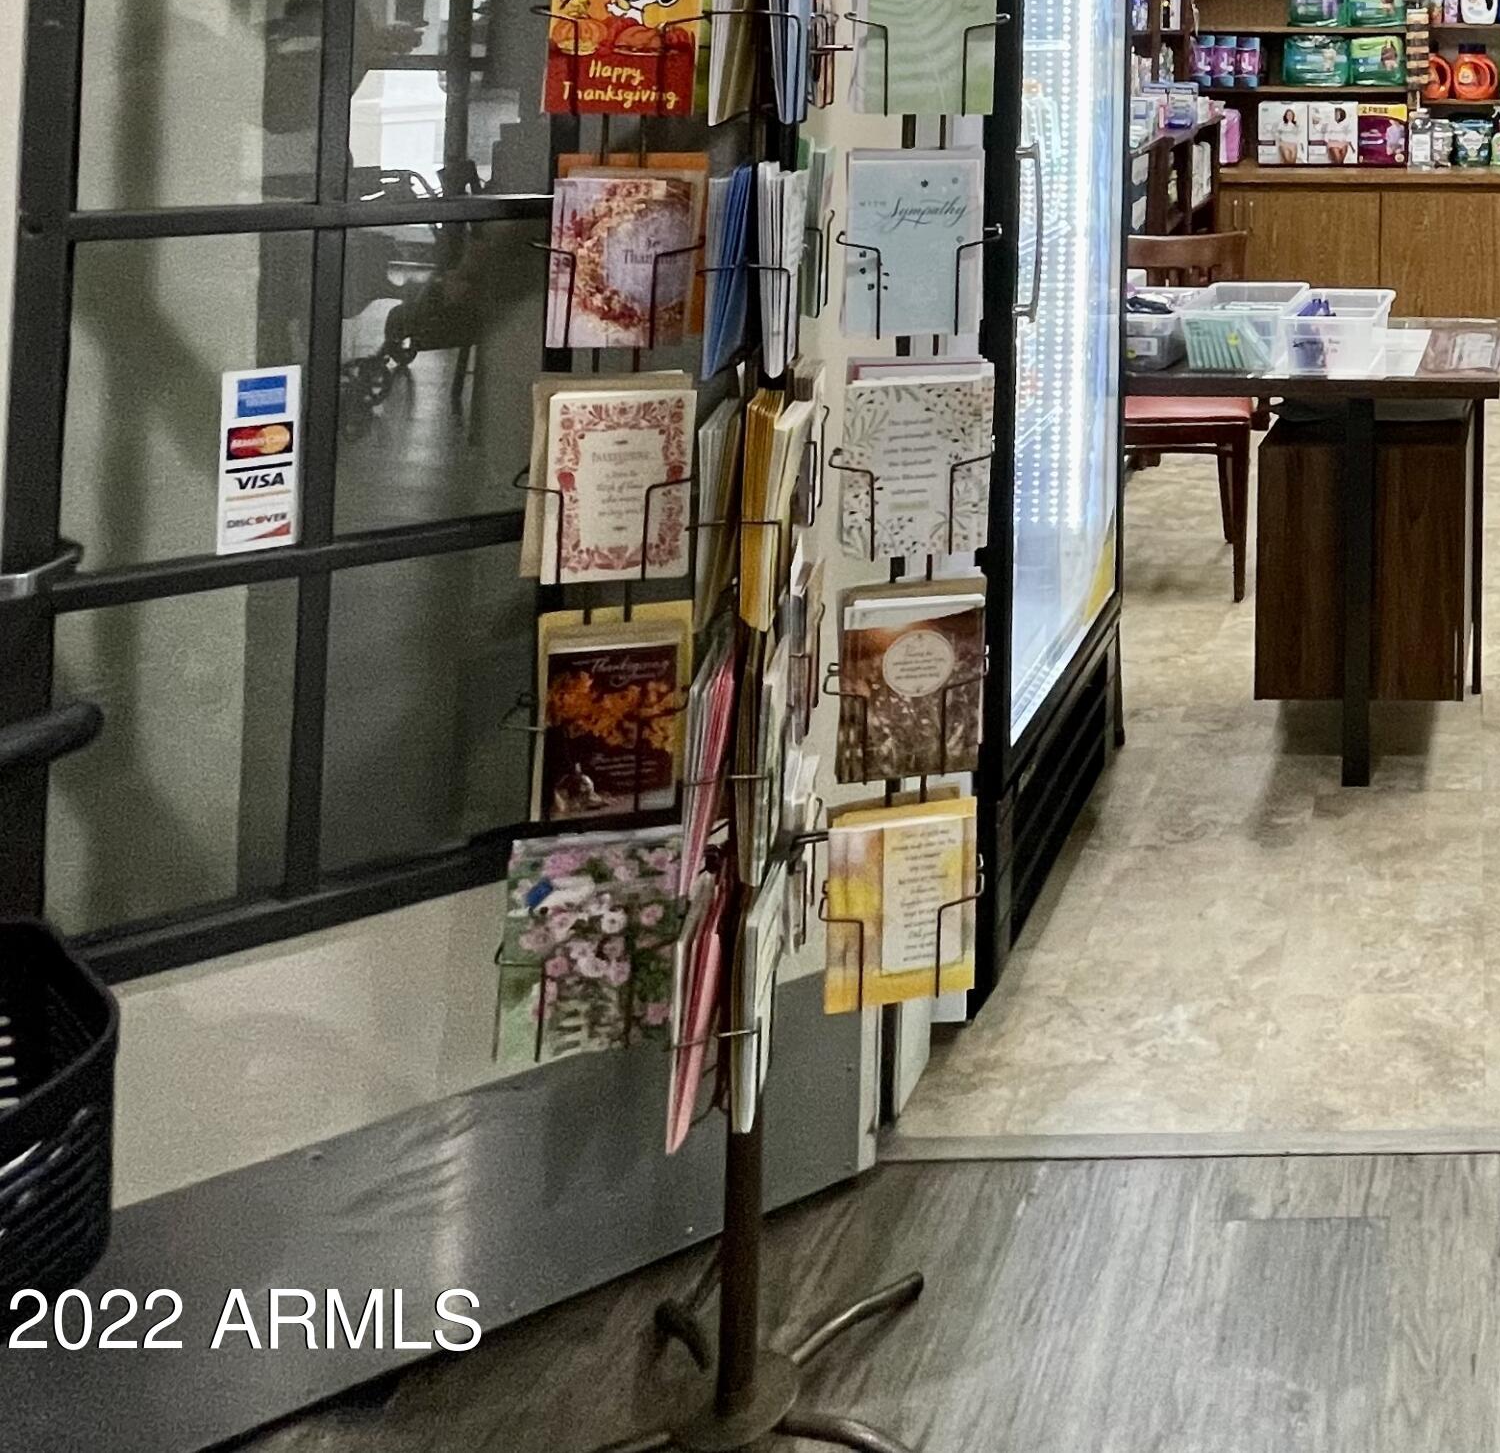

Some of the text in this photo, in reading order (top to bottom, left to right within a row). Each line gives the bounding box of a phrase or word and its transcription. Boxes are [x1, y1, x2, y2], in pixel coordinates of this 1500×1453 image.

[588, 58, 645, 86] Happy
[878, 195, 969, 232] Sympathy
[234, 471, 286, 491] VISA
[226, 511, 288, 529] DISCOVER
